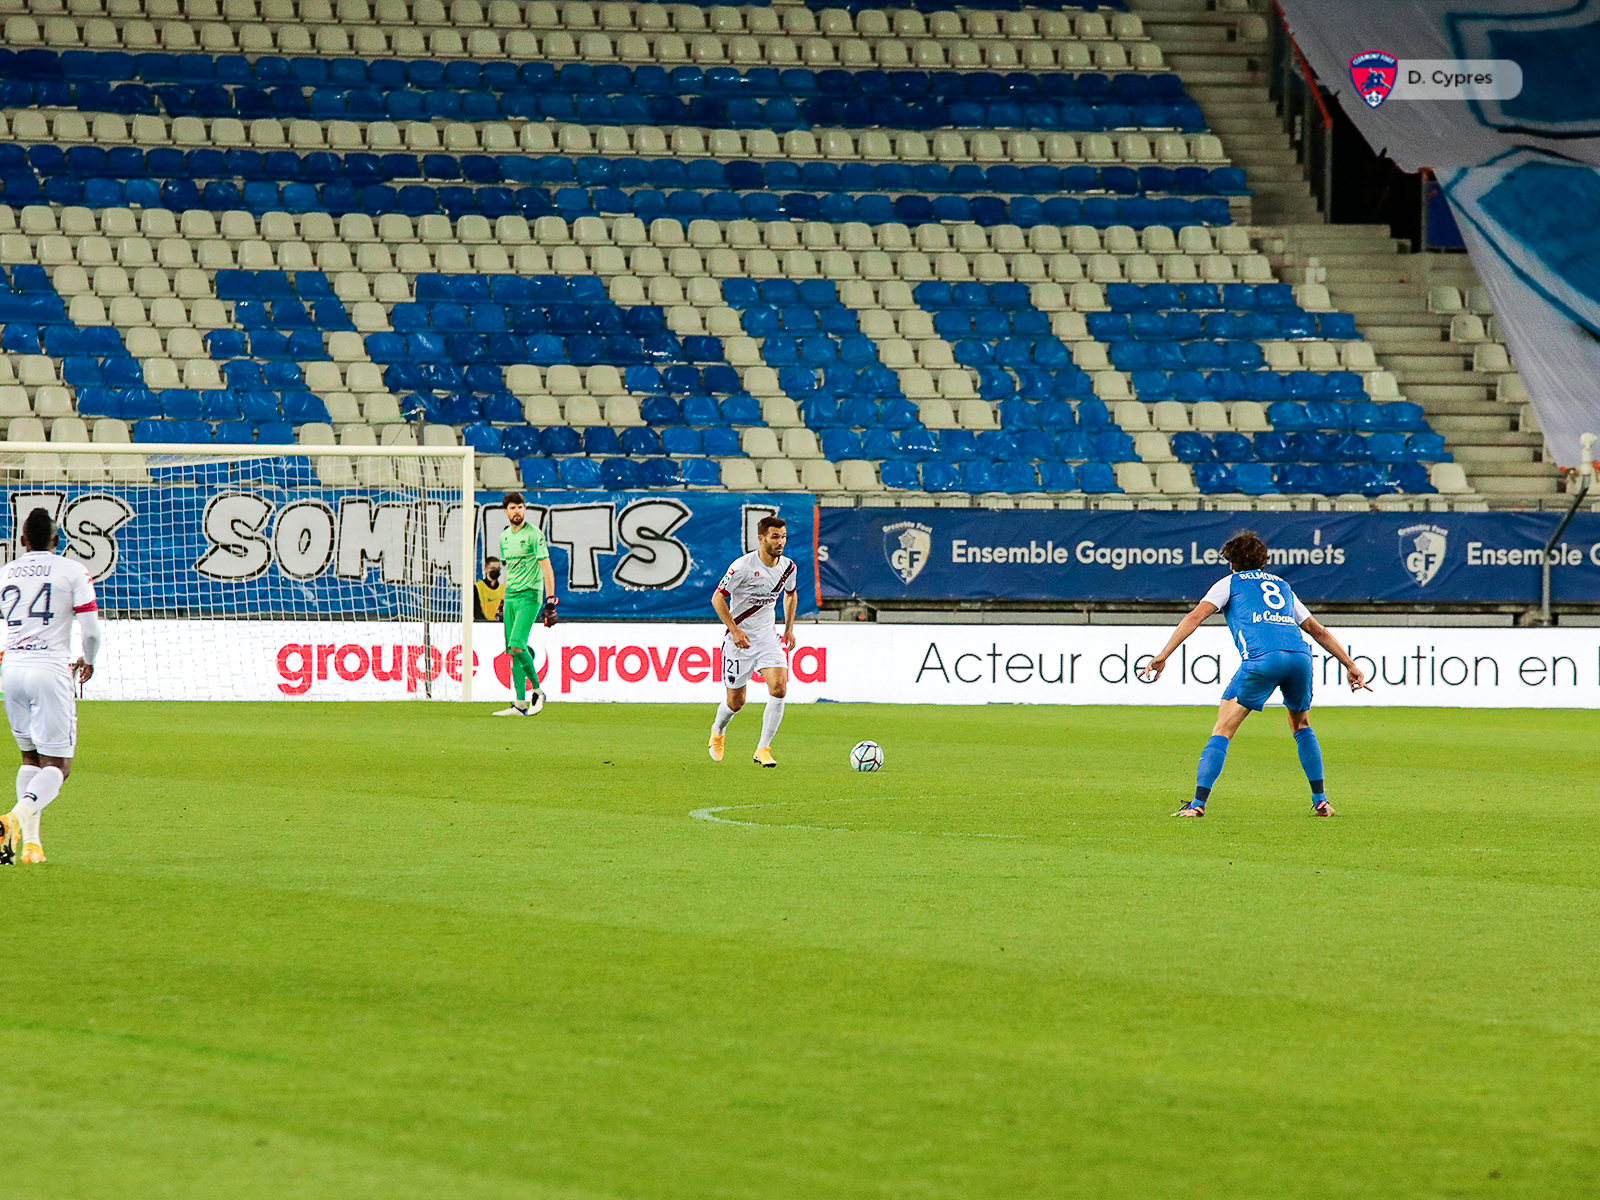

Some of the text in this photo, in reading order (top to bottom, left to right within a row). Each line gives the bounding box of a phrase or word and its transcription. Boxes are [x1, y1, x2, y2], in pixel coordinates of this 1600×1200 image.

[891, 549, 922, 570] GF
[951, 539, 1069, 564] Ensemble
[1075, 540, 1184, 570] Gagnons
[1267, 543, 1346, 565] mmets
[1406, 552, 1437, 573] GF
[8, 565, 52, 579] DOSSOU
[1, 583, 54, 627] 24
[1260, 580, 1286, 610] 8
[1252, 611, 1263, 624] le
[276, 642, 479, 696] groupe
[561, 635, 827, 694] provea
[726, 659, 740, 675] 21
[915, 642, 1082, 685] Acteur
[1099, 643, 1160, 685] de
[1182, 643, 1221, 685] la
[1309, 643, 1500, 687] ribution
[1518, 656, 1578, 687] en
